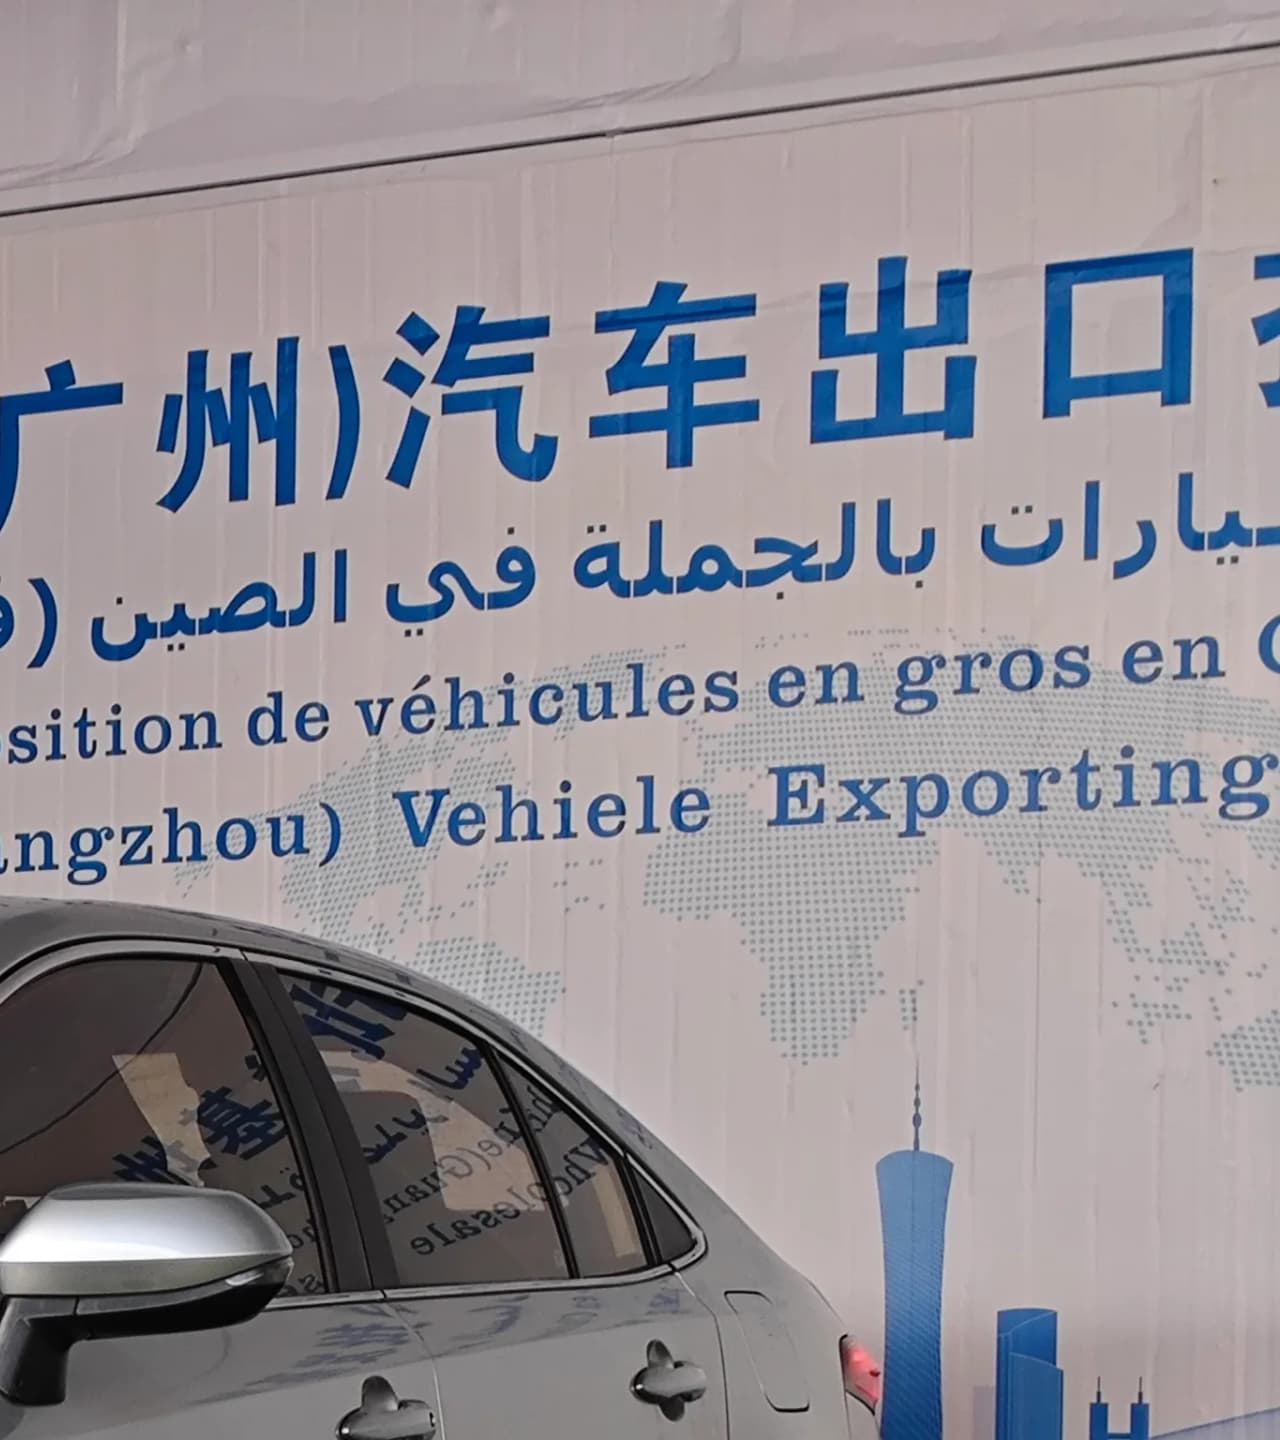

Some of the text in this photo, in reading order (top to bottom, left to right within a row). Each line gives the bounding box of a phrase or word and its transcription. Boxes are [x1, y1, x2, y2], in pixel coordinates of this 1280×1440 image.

[385, 526, 537, 637] في
[573, 498, 937, 601] بالجملة
[90, 549, 348, 662] الصين
[247, 692, 330, 747] de
[355, 662, 740, 737] véhicules
[768, 659, 864, 709] en
[894, 645, 1092, 717] gros
[1122, 632, 1226, 686] en
[393, 775, 711, 849] Vehiele
[768, 744, 1280, 838] Exporting
